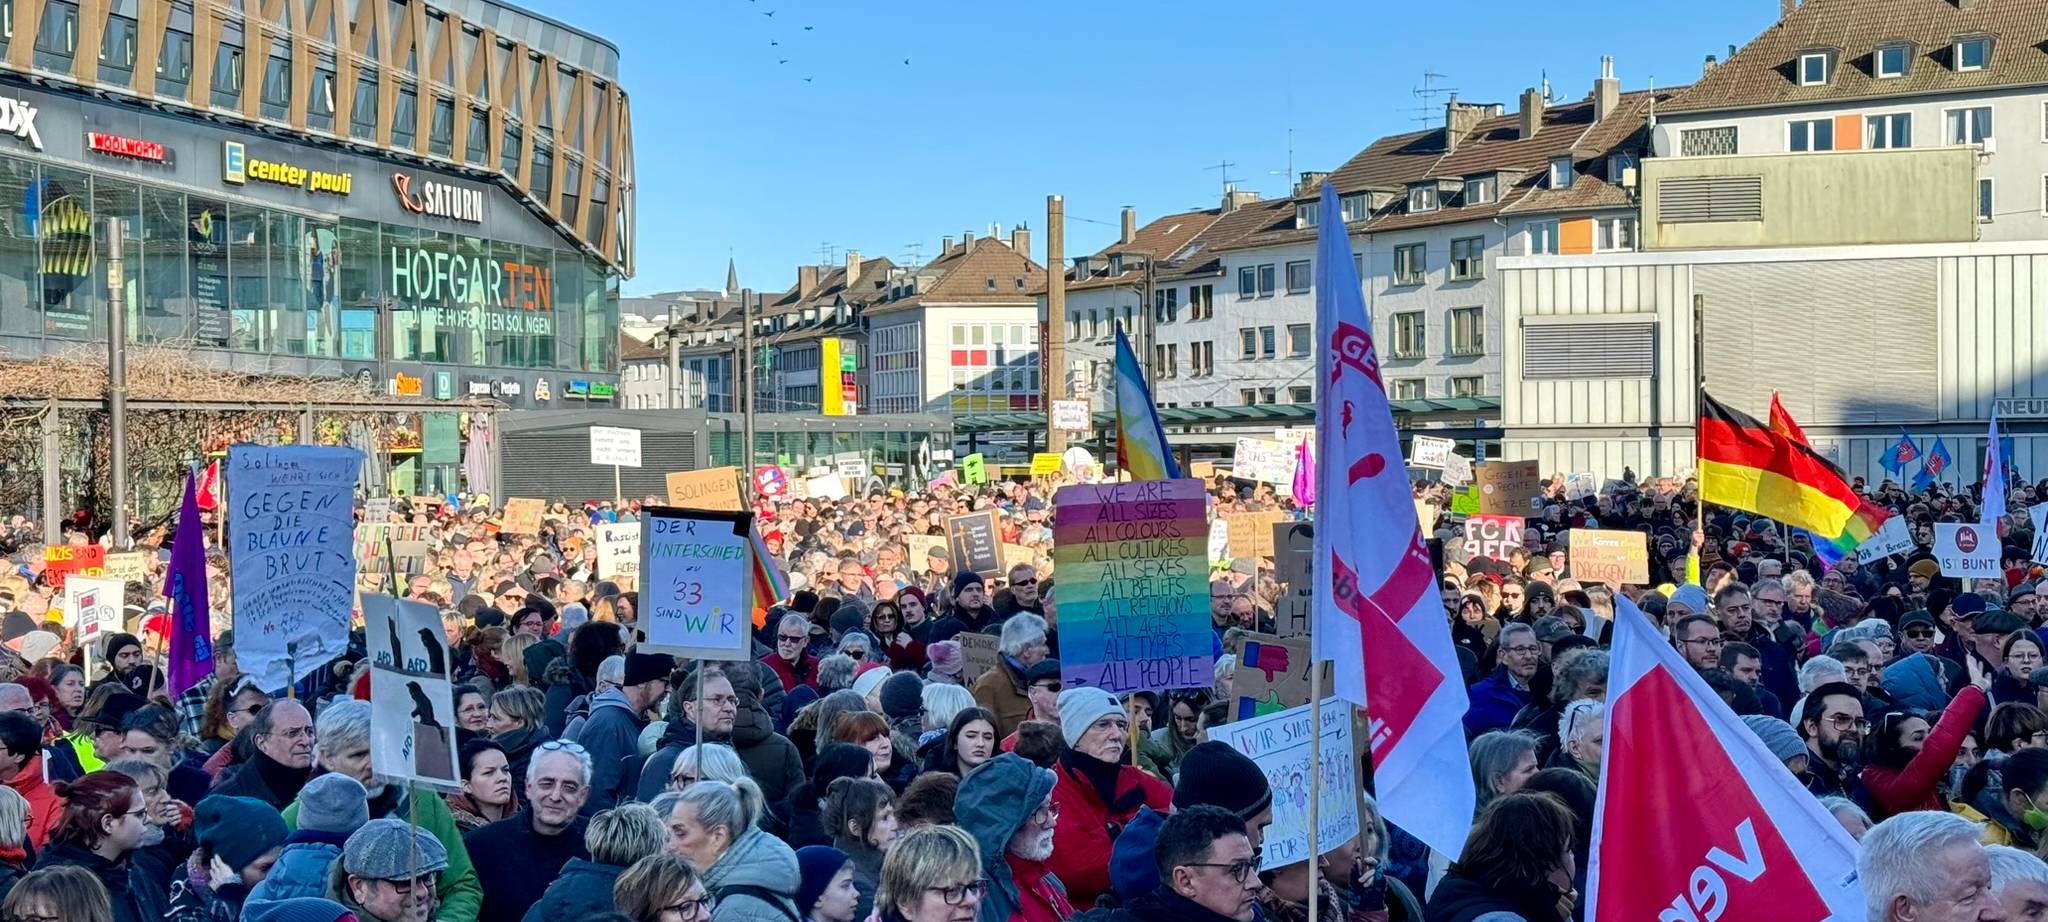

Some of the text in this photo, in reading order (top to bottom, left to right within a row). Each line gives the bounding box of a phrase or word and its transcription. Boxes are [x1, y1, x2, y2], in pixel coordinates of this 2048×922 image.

[94, 133, 164, 161] WOOLWORTH
[248, 158, 307, 187] center
[309, 170, 352, 196] pauli
[424, 181, 483, 223] SATURN
[506, 314, 551, 334] SOLNGEN
[675, 478, 735, 502] SOLINGEN
[1094, 481, 1173, 504] WE ARE
[244, 490, 340, 520] GEGEN
[1096, 502, 1178, 523] ALL SIZES
[273, 515, 302, 531] DIE
[655, 519, 696, 536] DER
[1084, 519, 1182, 543] ALL COLOURS
[1465, 517, 1521, 543] FCK
[247, 526, 329, 552] BLAUNE
[650, 541, 744, 561] UNTERSCHIED
[1082, 544, 1116, 563] ALL
[1118, 537, 1189, 560] CULTURES
[616, 561, 639, 574] ALTER
[1100, 558, 1187, 582] ALL SEXES
[1575, 560, 1626, 580] DAGEGEN
[1942, 558, 1996, 570] IST BUNT
[1101, 577, 1186, 601] ALL BELIEFS
[655, 606, 682, 619] SIND
[1093, 594, 1192, 620] ALL RELIGIONS
[1103, 614, 1178, 639] ALL AGES
[962, 635, 997, 649] DEMOK
[1102, 633, 1184, 662] ALL TYPES
[377, 650, 391, 666] AfD
[407, 658, 427, 673] AfD
[1099, 656, 1202, 692] ALL PEOPLE
[1240, 727, 1278, 755] WIR
[1320, 710, 1338, 728] EHR
[402, 734, 413, 761] AfD
[1269, 811, 1356, 861] FÜR EMOKRATIE
